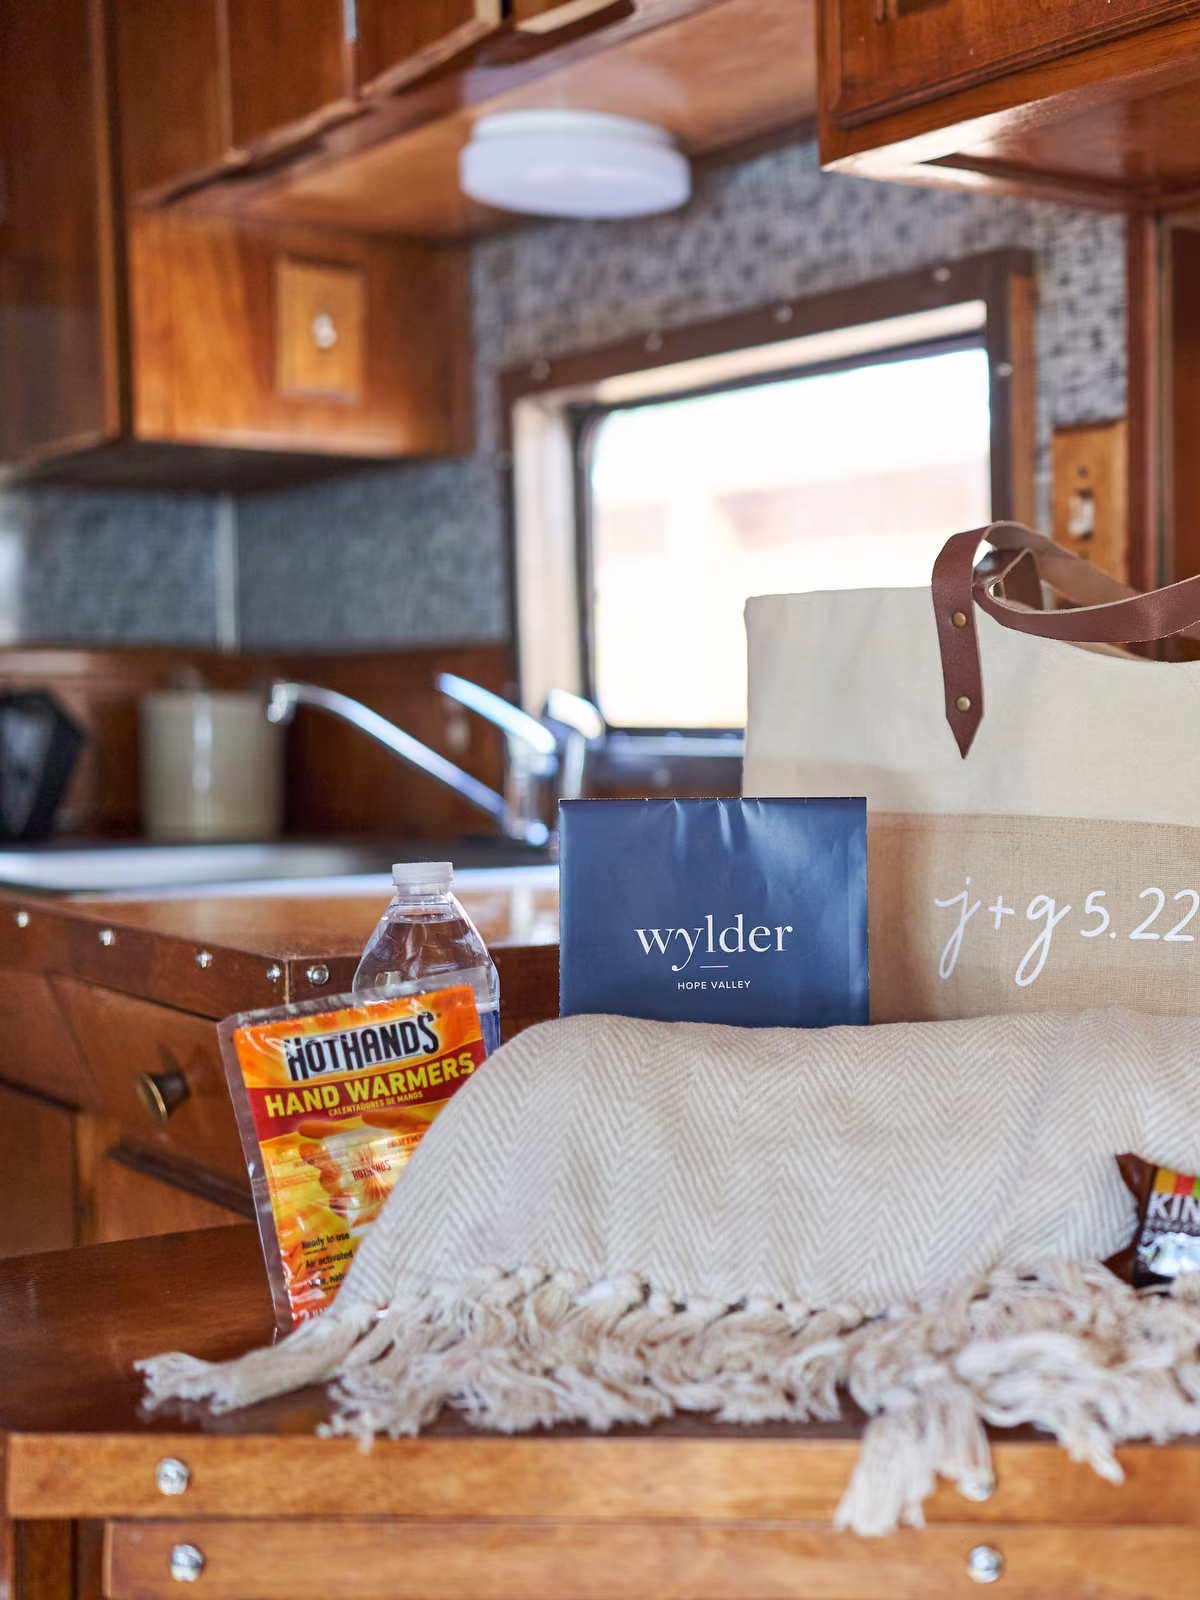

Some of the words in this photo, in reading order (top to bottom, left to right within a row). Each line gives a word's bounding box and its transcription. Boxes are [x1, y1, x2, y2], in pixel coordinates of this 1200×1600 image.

[634, 914, 793, 972] wylder
[678, 981, 707, 990] HOPE
[710, 980, 751, 990] VALLEY
[265, 1085, 340, 1118] HAND
[344, 1051, 476, 1103] WARMERS
[328, 1100, 384, 1117] CALENTADORES
[397, 1090, 423, 1101] MANOS
[301, 1236, 324, 1250] Ready
[326, 1234, 335, 1244] to
[336, 1232, 350, 1242] use
